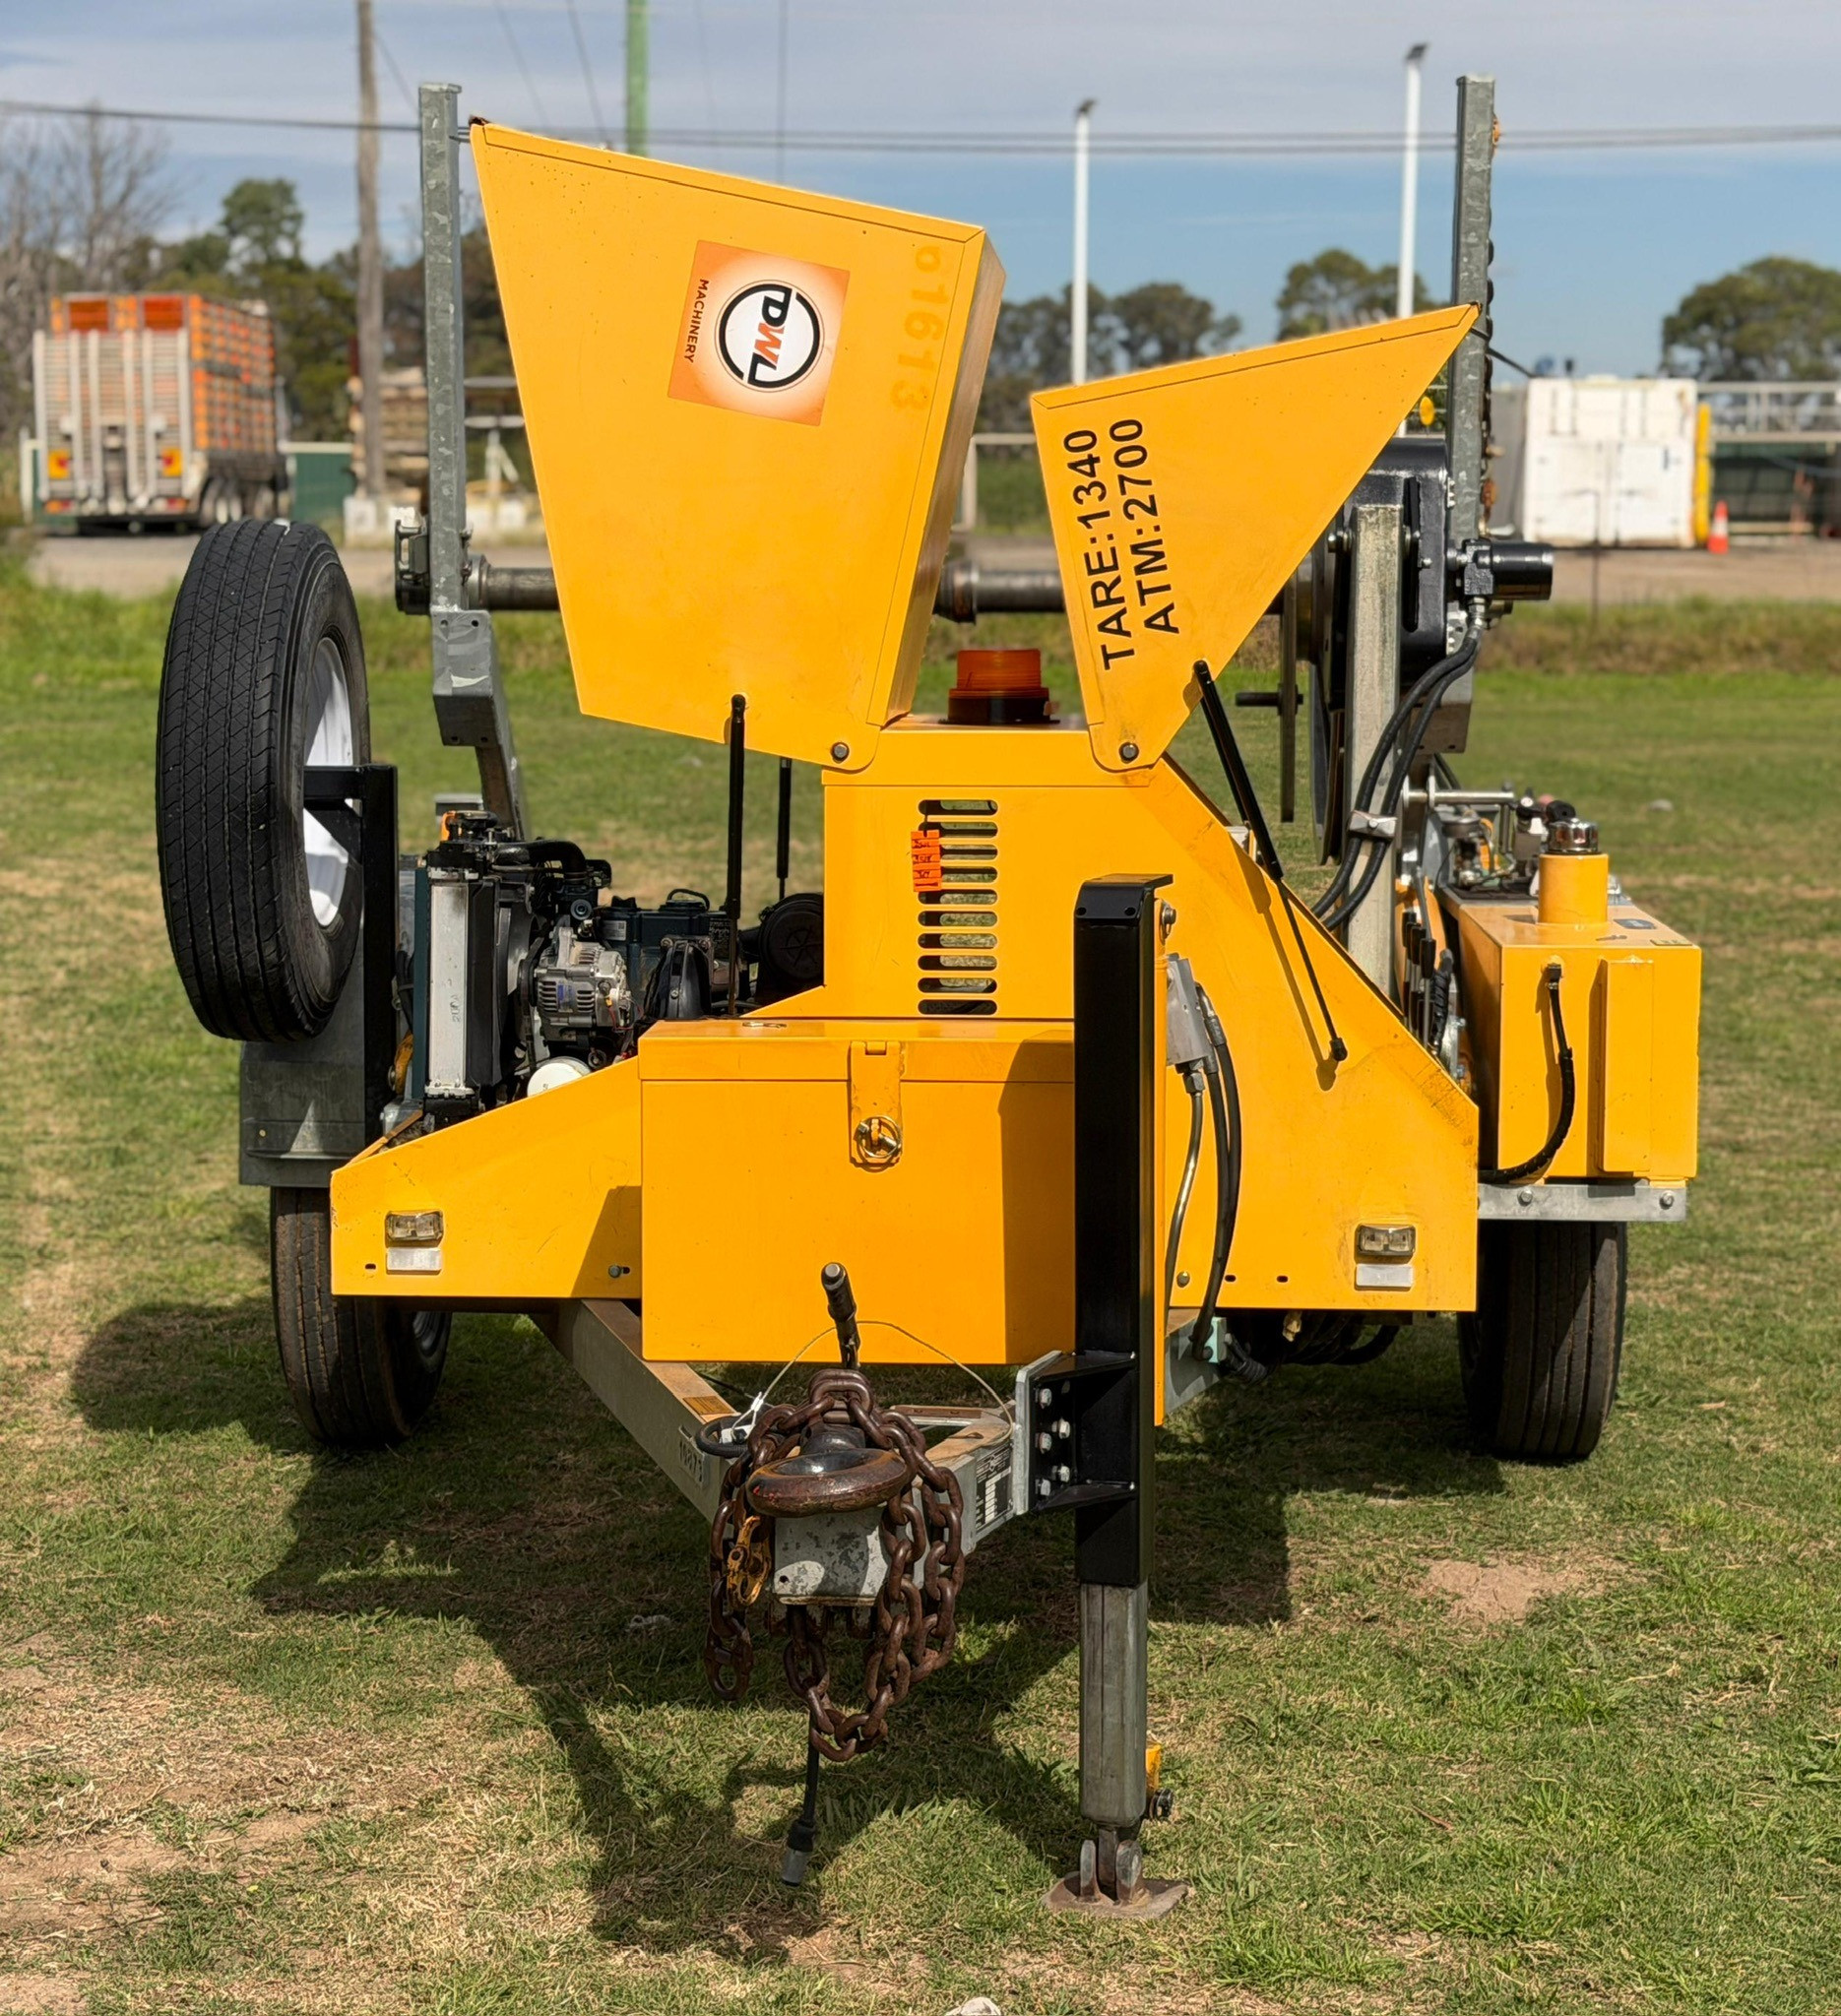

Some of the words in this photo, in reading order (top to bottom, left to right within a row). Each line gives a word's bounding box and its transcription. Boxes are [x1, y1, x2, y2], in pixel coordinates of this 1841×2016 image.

[684, 279, 709, 363] MACHINERY
[748, 288, 793, 385] DWL
[1063, 429, 1135, 670] TARE:1340
[1109, 418, 1179, 634] ATM:2700
